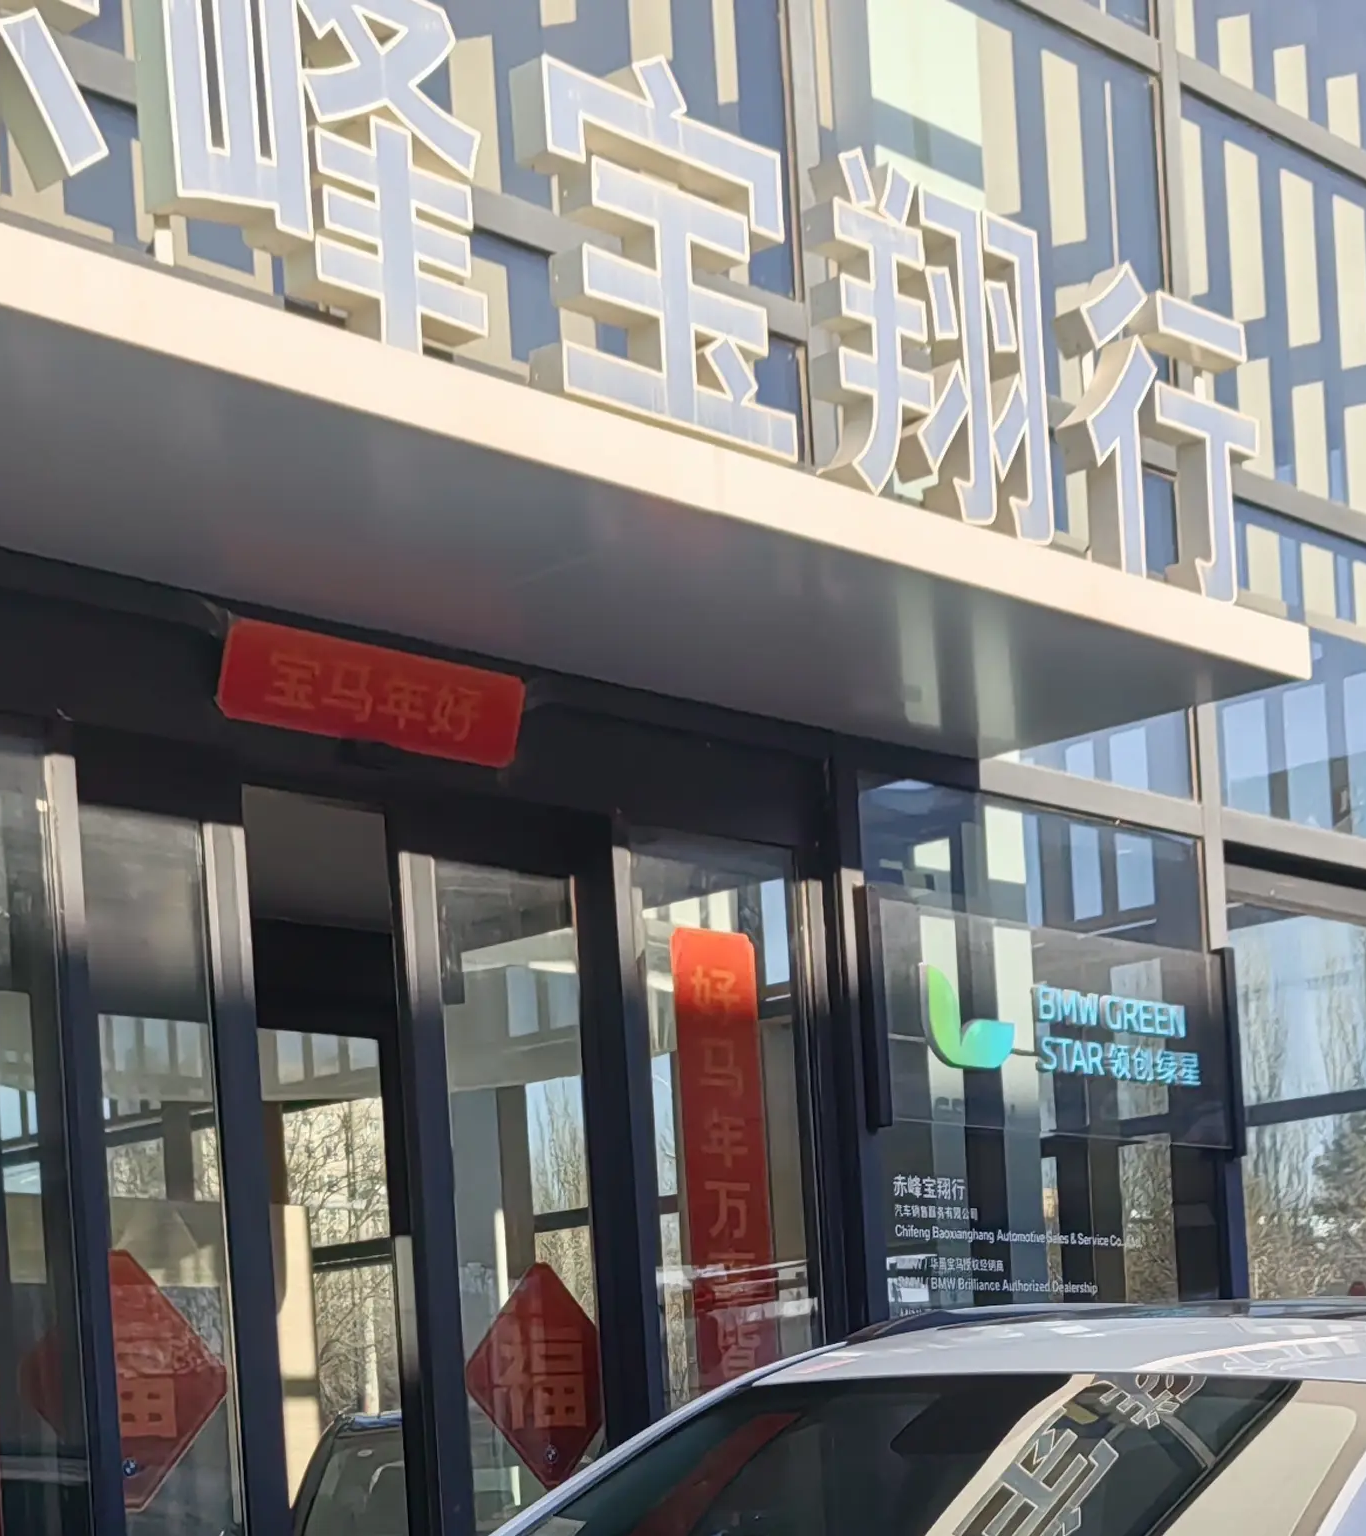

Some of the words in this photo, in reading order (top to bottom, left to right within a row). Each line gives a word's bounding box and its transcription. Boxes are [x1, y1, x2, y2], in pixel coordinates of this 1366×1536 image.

[264, 651, 483, 742] 宝马年好
[1037, 984, 1098, 1026] BMW
[1101, 995, 1187, 1038] GREEN
[1041, 1036, 1105, 1076] STAR
[1107, 1043, 1202, 1086] 领创绿星
[893, 1174, 966, 1201] 赤峰宝翔行
[895, 1204, 979, 1221] 汽车销售服务有限公司
[895, 1224, 931, 1242] Chifeng
[996, 1229, 1046, 1244] Automotive
[1046, 1231, 1070, 1245] Sales
[1070, 1232, 1077, 1246] &
[1078, 1232, 1109, 1247] Service
[931, 1276, 956, 1290] BMW
[957, 1278, 1001, 1292] Brilliance
[1002, 1279, 1050, 1293] Authorized
[1052, 1280, 1099, 1295] Dealership
[491, 1312, 586, 1431] 福
